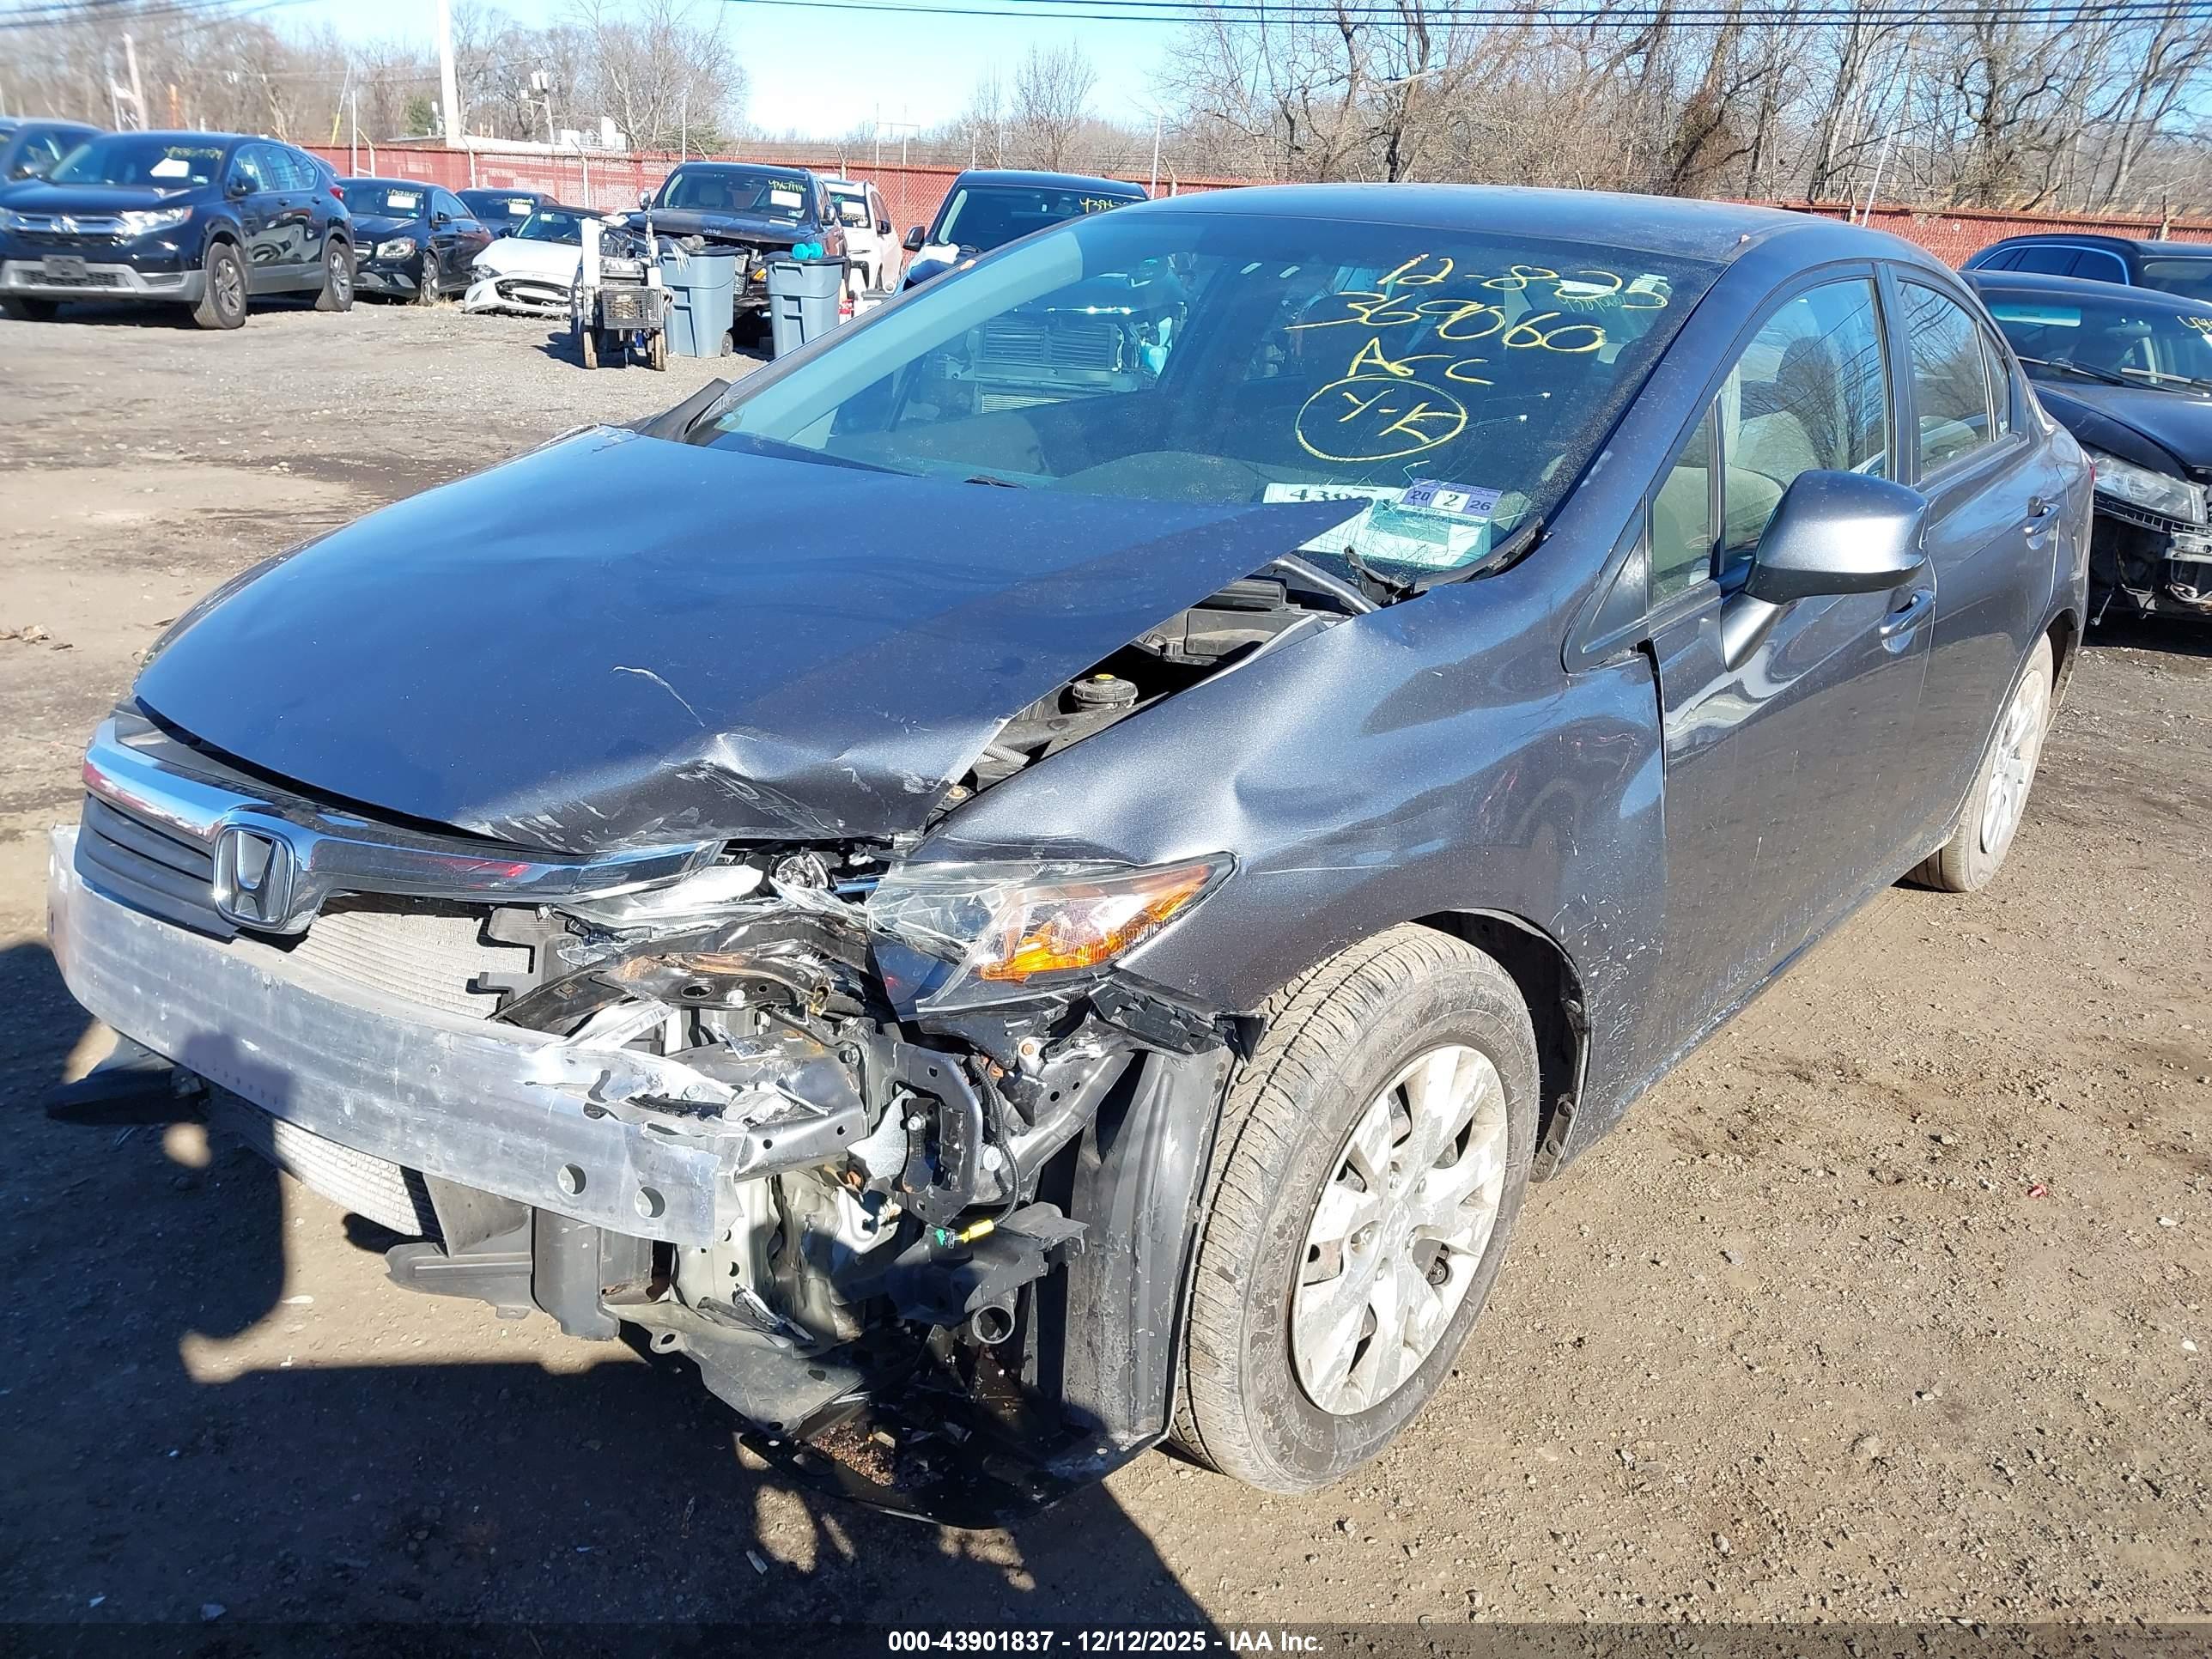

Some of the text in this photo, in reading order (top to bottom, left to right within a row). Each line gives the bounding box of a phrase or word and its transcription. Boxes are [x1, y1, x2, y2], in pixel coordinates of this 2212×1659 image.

[1409, 489, 1492, 511] 20 2 26
